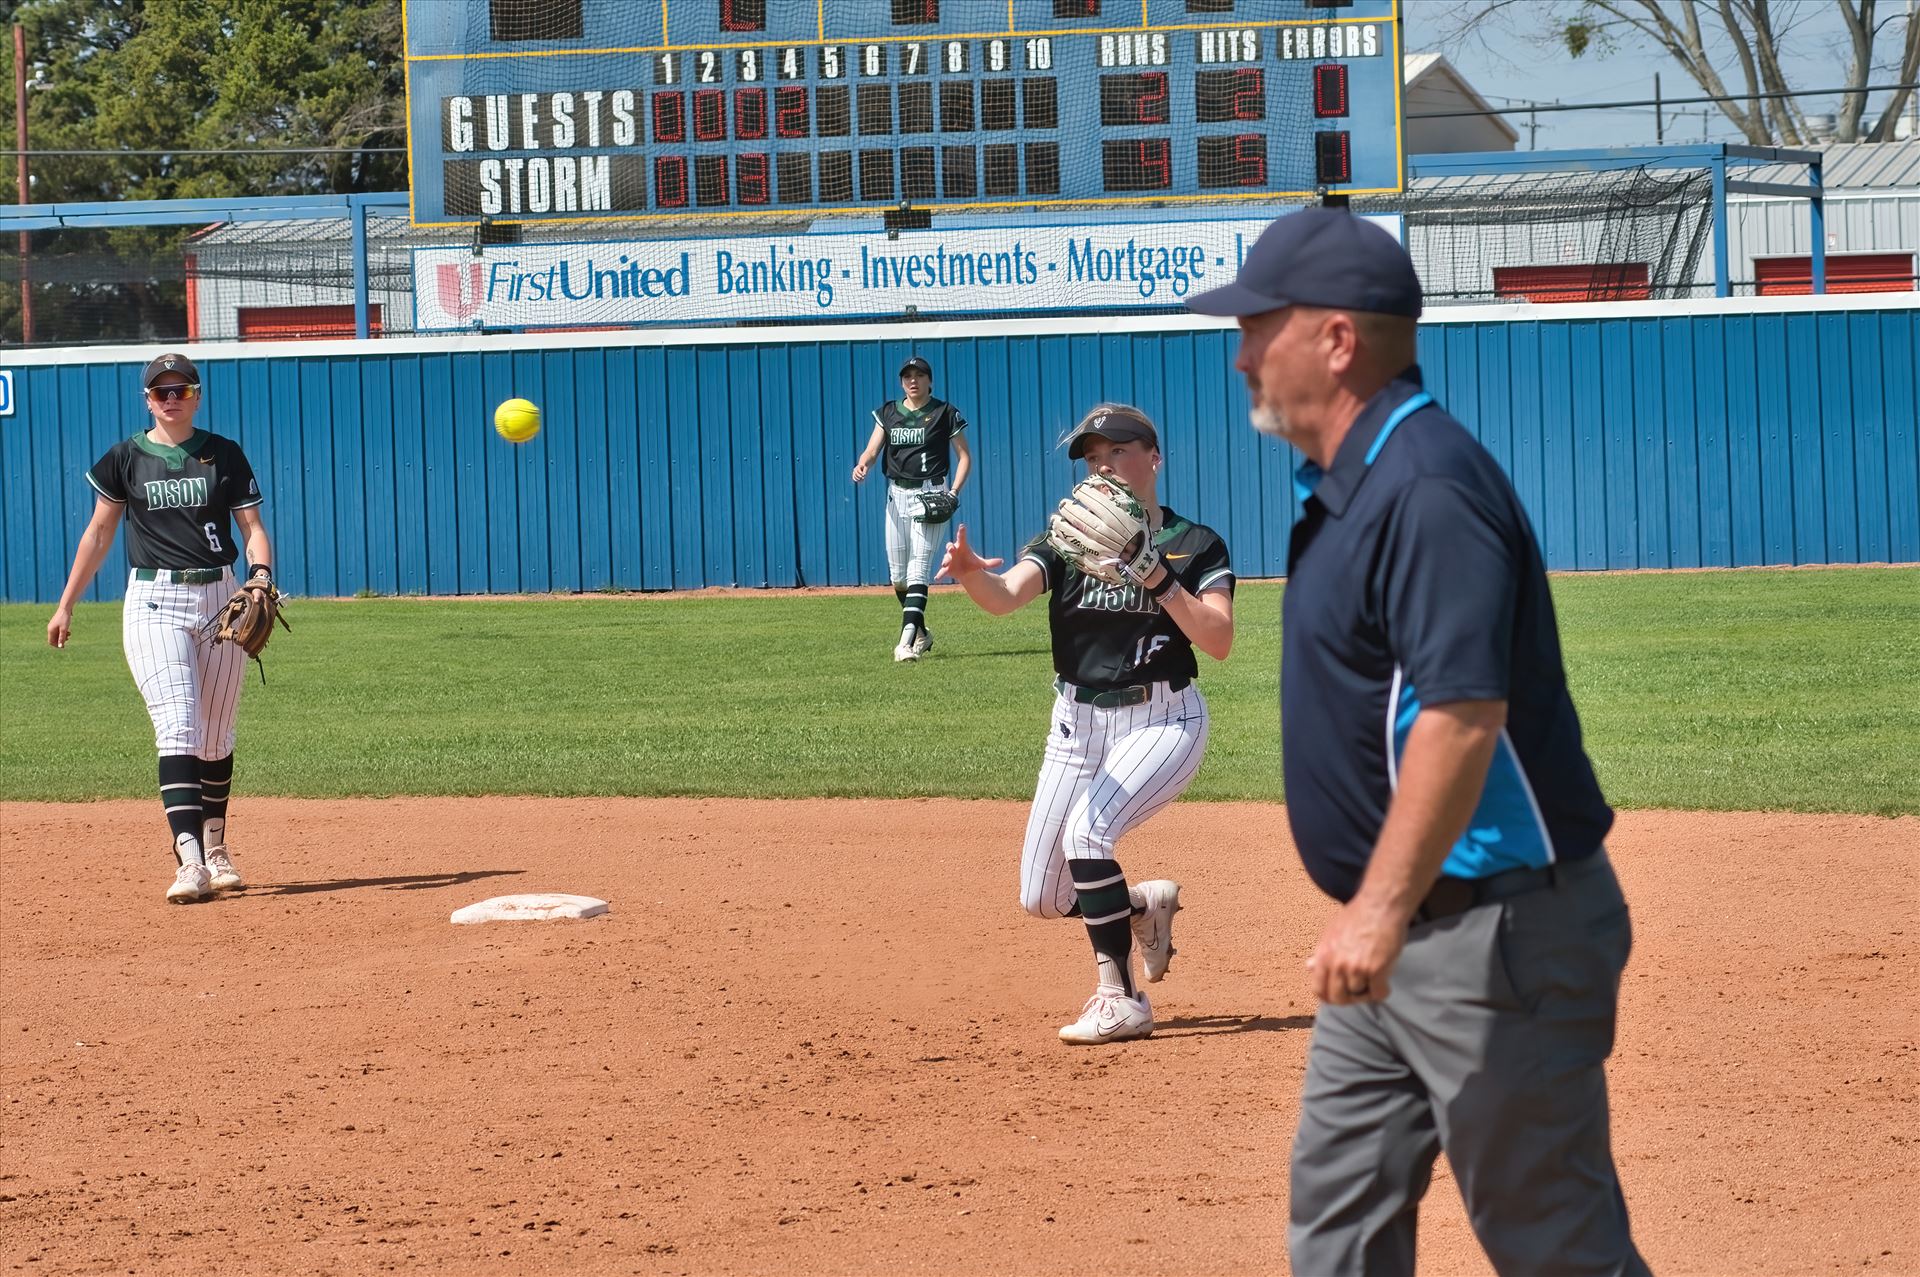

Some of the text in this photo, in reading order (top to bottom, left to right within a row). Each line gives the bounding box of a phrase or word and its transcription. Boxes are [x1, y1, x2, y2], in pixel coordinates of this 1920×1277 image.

[663, 25, 1377, 84] 1 2 3 4 5 6 7 8 9 10 RUNS HITS ERRORS
[450, 65, 1345, 152] GUESTS 0 0 0 2 2 2 0
[479, 155, 611, 214] STORM
[658, 156, 685, 206] 0
[742, 153, 767, 202] 3
[1139, 140, 1169, 185] 4
[1235, 133, 1264, 186] 5
[486, 252, 690, 301] FirstUnited
[716, 244, 833, 308] Banking
[861, 240, 1038, 289] Investments
[1067, 237, 1206, 298] Mortgage
[890, 427, 925, 445] BISON
[921, 452, 927, 472] 1
[144, 477, 208, 511] BISON
[204, 521, 222, 552] 6
